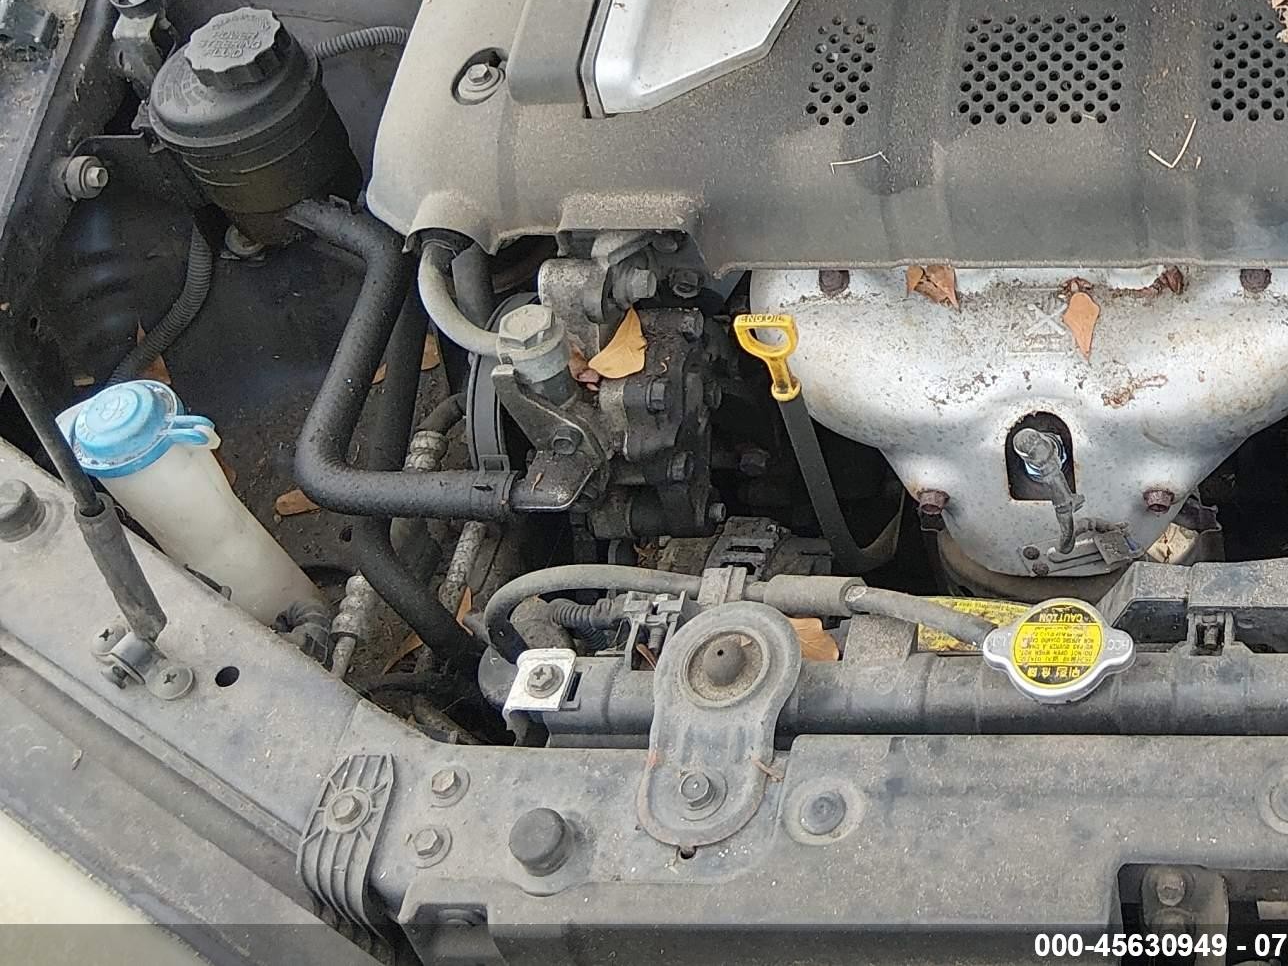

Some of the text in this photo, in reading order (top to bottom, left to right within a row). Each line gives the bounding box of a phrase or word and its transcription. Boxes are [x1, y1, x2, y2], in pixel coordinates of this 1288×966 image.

[739, 313, 784, 323] ENG OIL
[1039, 613, 1084, 622] CAUTION
